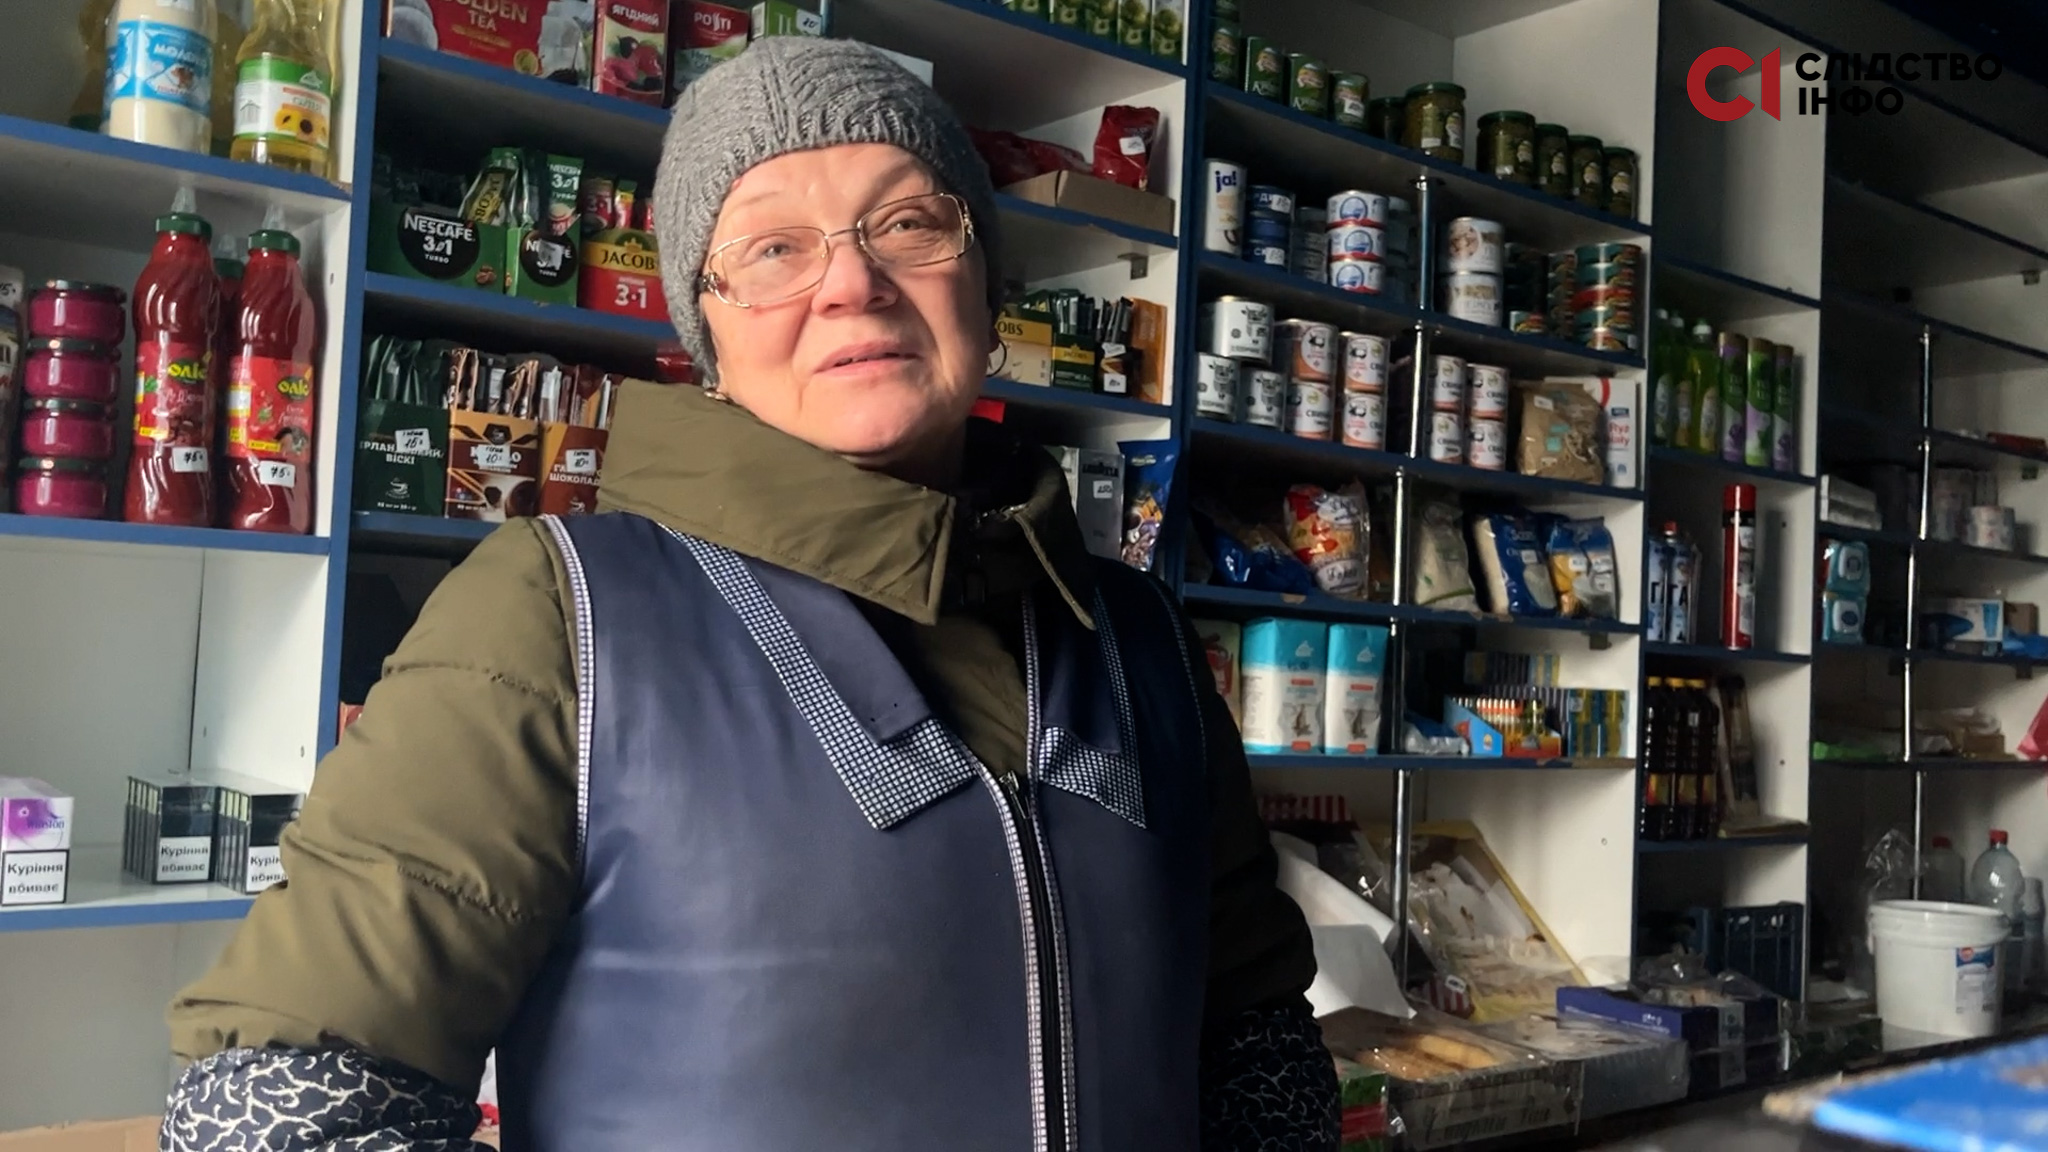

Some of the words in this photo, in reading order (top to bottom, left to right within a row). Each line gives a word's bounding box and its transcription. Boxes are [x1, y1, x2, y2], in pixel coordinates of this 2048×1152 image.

[468, 9, 497, 32] TEA
[1215, 171, 1237, 193] ja!
[425, 254, 449, 264] TURBO
[601, 249, 656, 271] JACOB
[997, 319, 1024, 337] OBS
[385, 453, 415, 465] ВІСКІ
[161, 845, 208, 857] Куріння
[250, 855, 280, 867] Курін
[7, 862, 63, 876] Куріння
[162, 863, 206, 873] вбиває
[9, 882, 59, 895] вбиває
